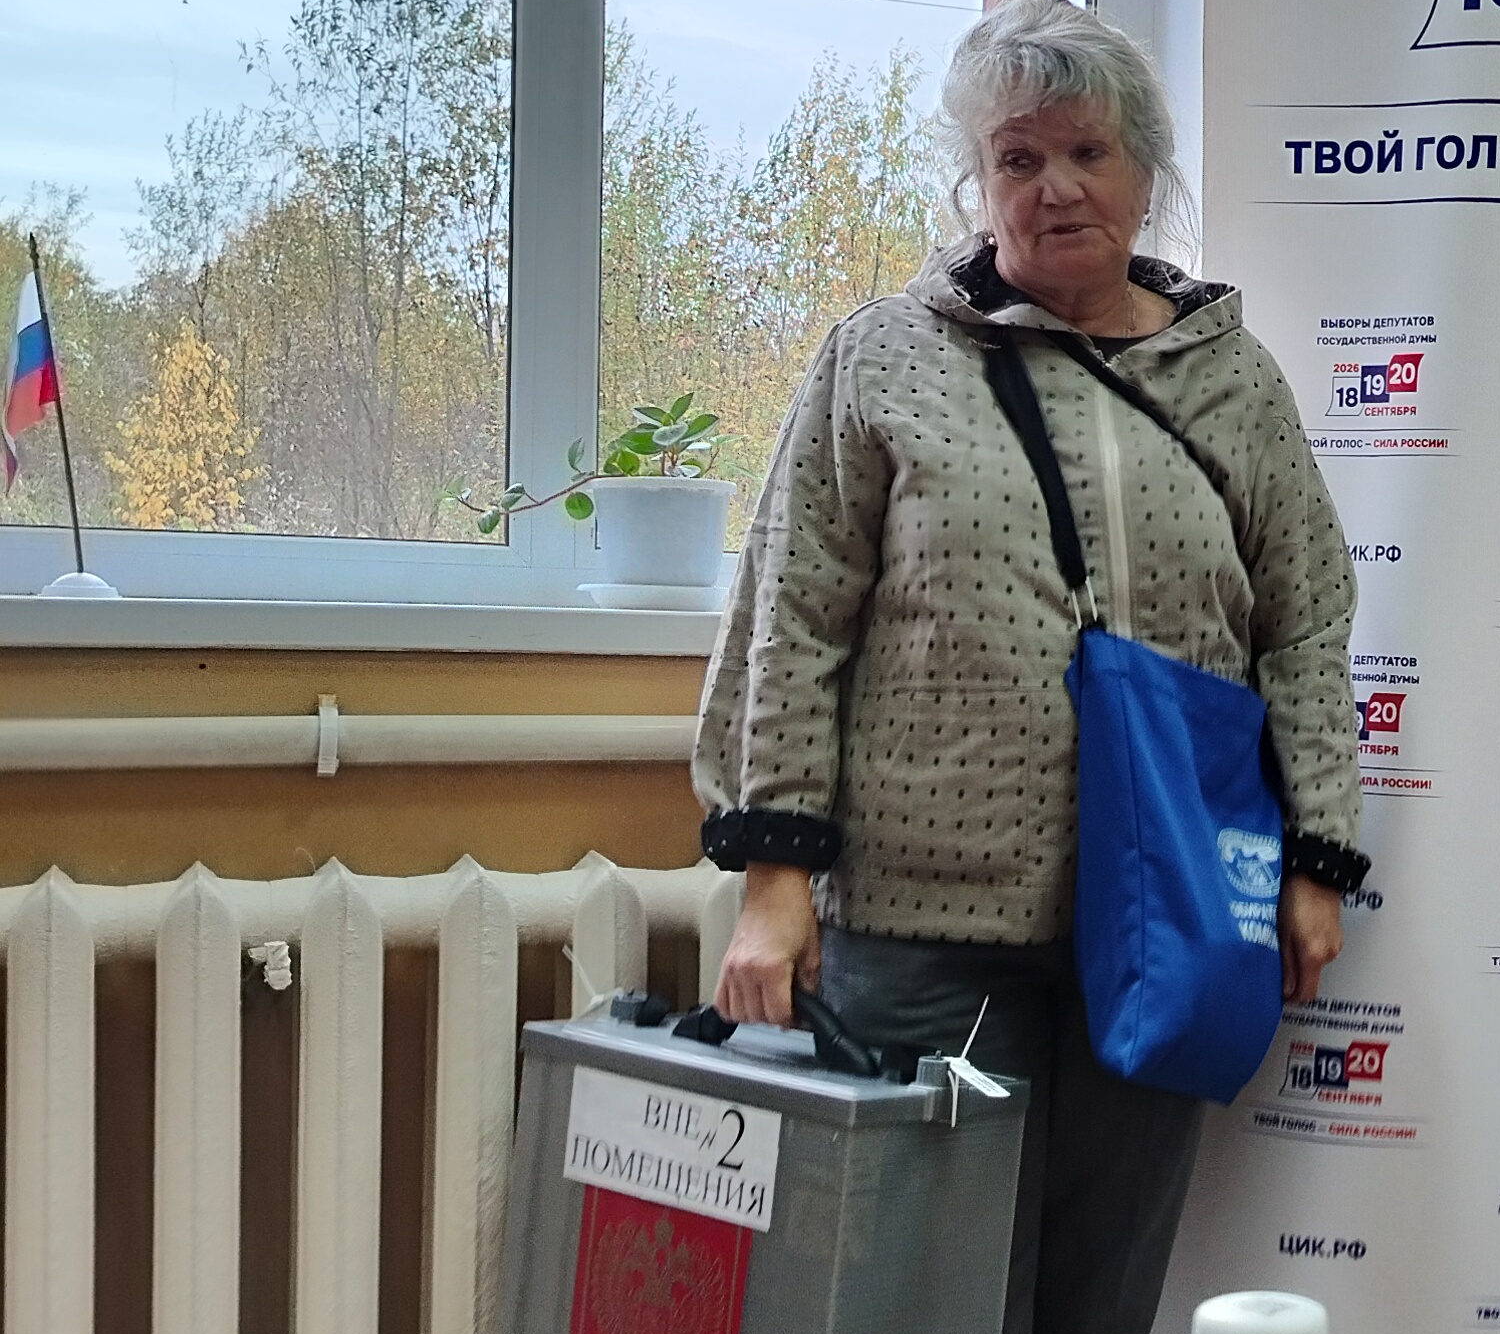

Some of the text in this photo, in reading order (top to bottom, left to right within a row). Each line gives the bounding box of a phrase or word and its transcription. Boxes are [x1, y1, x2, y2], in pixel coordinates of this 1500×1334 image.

[1284, 129, 1404, 175] ТВОЙ
[1321, 316, 1434, 329] ВЫБОРЫ ДЕПУТАТОВ
[1317, 334, 1437, 346] ГОСУДАРСТВЕННОЙ ДУМЫ
[1334, 364, 1359, 372] 2026
[1336, 363, 1415, 407] 18 19 20
[1365, 407, 1416, 416] СЕНТЯБРЯ
[1330, 439, 1363, 448] ГОЛОС
[1374, 439, 1398, 448] СИЛА
[1401, 439, 1448, 448] РОССИИ!
[1347, 544, 1402, 563] ИК.РФ
[1354, 655, 1417, 667] ДЕПУТАТОВ
[1389, 675, 1419, 684] ДУМЫ
[1369, 702, 1397, 723] 20
[1358, 744, 1398, 755] НТЯБРЯ
[1382, 778, 1431, 789] РОССИИ!
[1318, 1055, 1341, 1081] 19
[1348, 1049, 1379, 1073] 20
[643, 1095, 702, 1140] ВНЕ
[716, 1109, 745, 1170] 2
[571, 1134, 765, 1216] ПОМЕЩЕНИЯ
[1279, 1233, 1367, 1261] ЦИК.РФ
